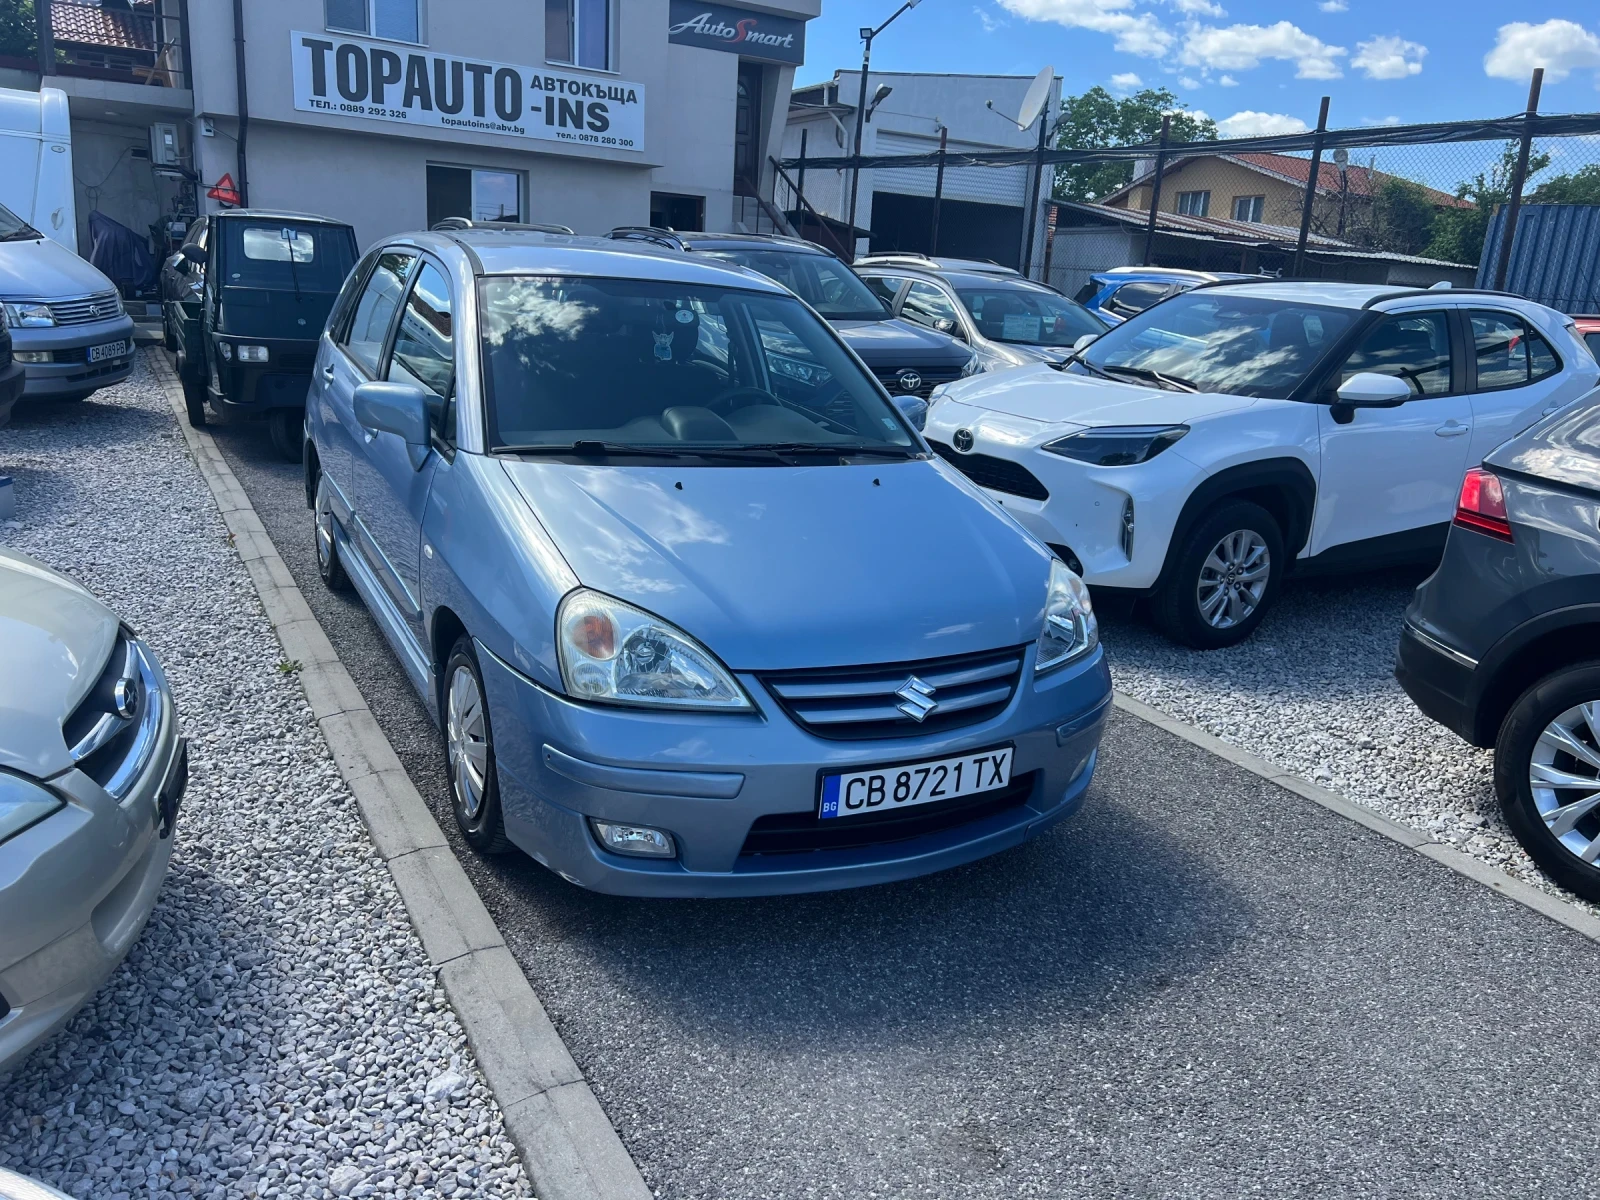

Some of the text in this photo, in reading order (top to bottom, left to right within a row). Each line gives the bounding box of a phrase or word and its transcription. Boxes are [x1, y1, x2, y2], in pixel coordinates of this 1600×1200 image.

[302, 38, 610, 133] TOPAUTO -INS
[530, 75, 638, 105] АВТОКЪЩА
[309, 99, 407, 119] ТЕЛ.: 0889 292 326
[441, 116, 525, 135] topautoins@abv.bg
[556, 132, 634, 147] тел.: 0878 280 300
[845, 753, 1007, 810] CB 8721 TX
[823, 801, 837, 813] BG
